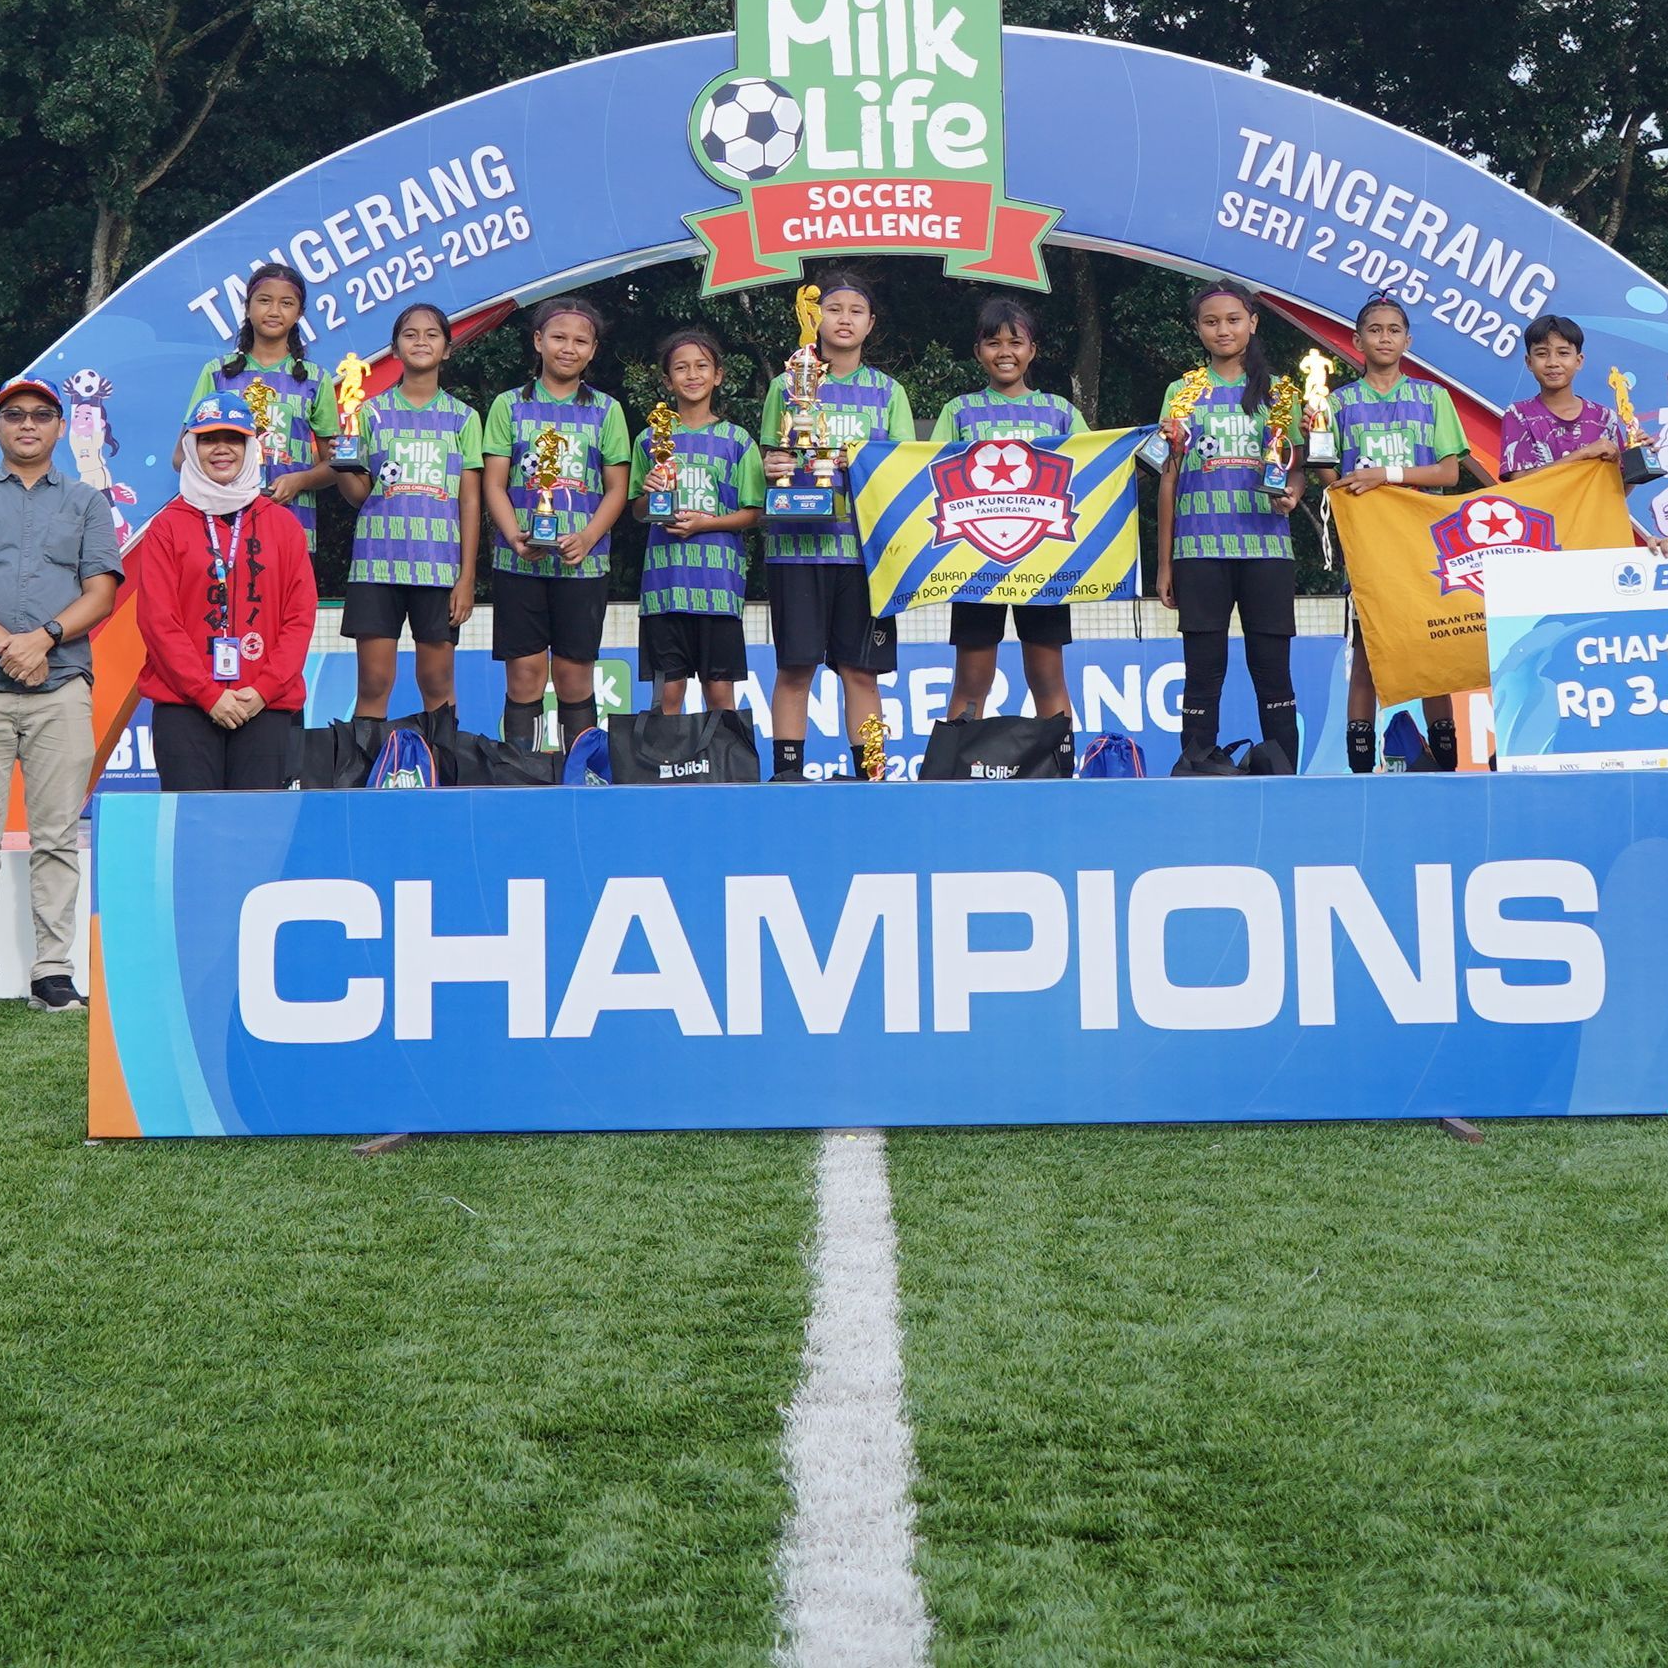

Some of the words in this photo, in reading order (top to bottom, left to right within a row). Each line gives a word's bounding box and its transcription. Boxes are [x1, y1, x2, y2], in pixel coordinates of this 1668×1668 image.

[804, 79, 988, 170] Life
[807, 183, 933, 211] SOCCER
[781, 214, 963, 243] CHALLENGE
[1236, 126, 1557, 321] TANGERANG
[187, 144, 517, 342] TAGERANG
[315, 292, 347, 331] 2
[344, 204, 531, 315] 2025-2026
[1216, 190, 1305, 251] SERI
[1306, 226, 1337, 263] 2
[1338, 239, 1523, 359] 2025-2026
[1209, 414, 1259, 436] Milk
[395, 441, 442, 463] Milk
[1219, 435, 1261, 457] Life
[1366, 433, 1412, 456] Milk
[401, 462, 442, 485] Life
[948, 497, 975, 512] SDN
[978, 495, 1046, 507] KUNCIRAN
[1049, 499, 1057, 508] 4
[975, 506, 1031, 515] TANGERANG
[1449, 553, 1475, 568] SDN
[930, 570, 968, 583] BUKAN
[970, 571, 1011, 583] PEMAIN
[1013, 571, 1046, 584] YANG
[1048, 570, 1082, 582] HEBAT
[922, 585, 948, 599] DOA
[952, 584, 994, 597] ORANG
[996, 585, 1018, 597] TUA
[1030, 586, 1064, 598] GURU
[1066, 583, 1102, 596] YANG
[1102, 581, 1128, 594] KUAT
[1427, 615, 1461, 628] BUKAN
[1464, 612, 1486, 622] PEM
[1430, 629, 1451, 640] DOA
[1452, 623, 1487, 636] ORANG
[1556, 680, 1616, 728] Rp
[674, 759, 710, 778] blibli
[802, 753, 848, 782] eri
[238, 858, 1606, 1044] CHAMPIONS
